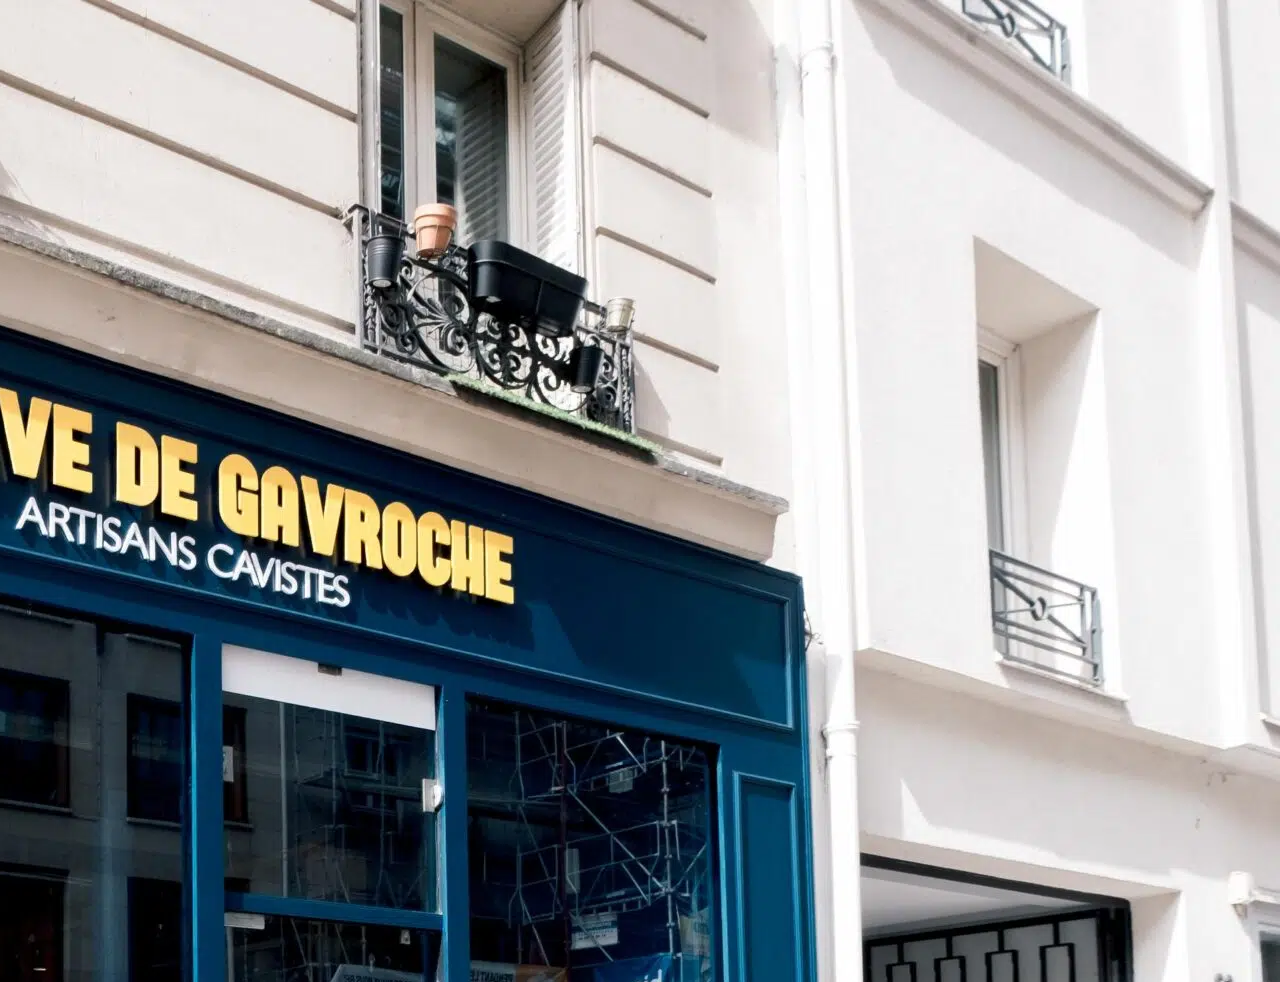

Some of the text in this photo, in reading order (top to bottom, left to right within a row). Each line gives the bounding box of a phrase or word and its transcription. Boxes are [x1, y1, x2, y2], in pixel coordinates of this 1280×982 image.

[16, 496, 350, 607] ARTISANS CAVISTES
[116, 421, 197, 521] DE
[219, 454, 514, 604] GAVROCHE
